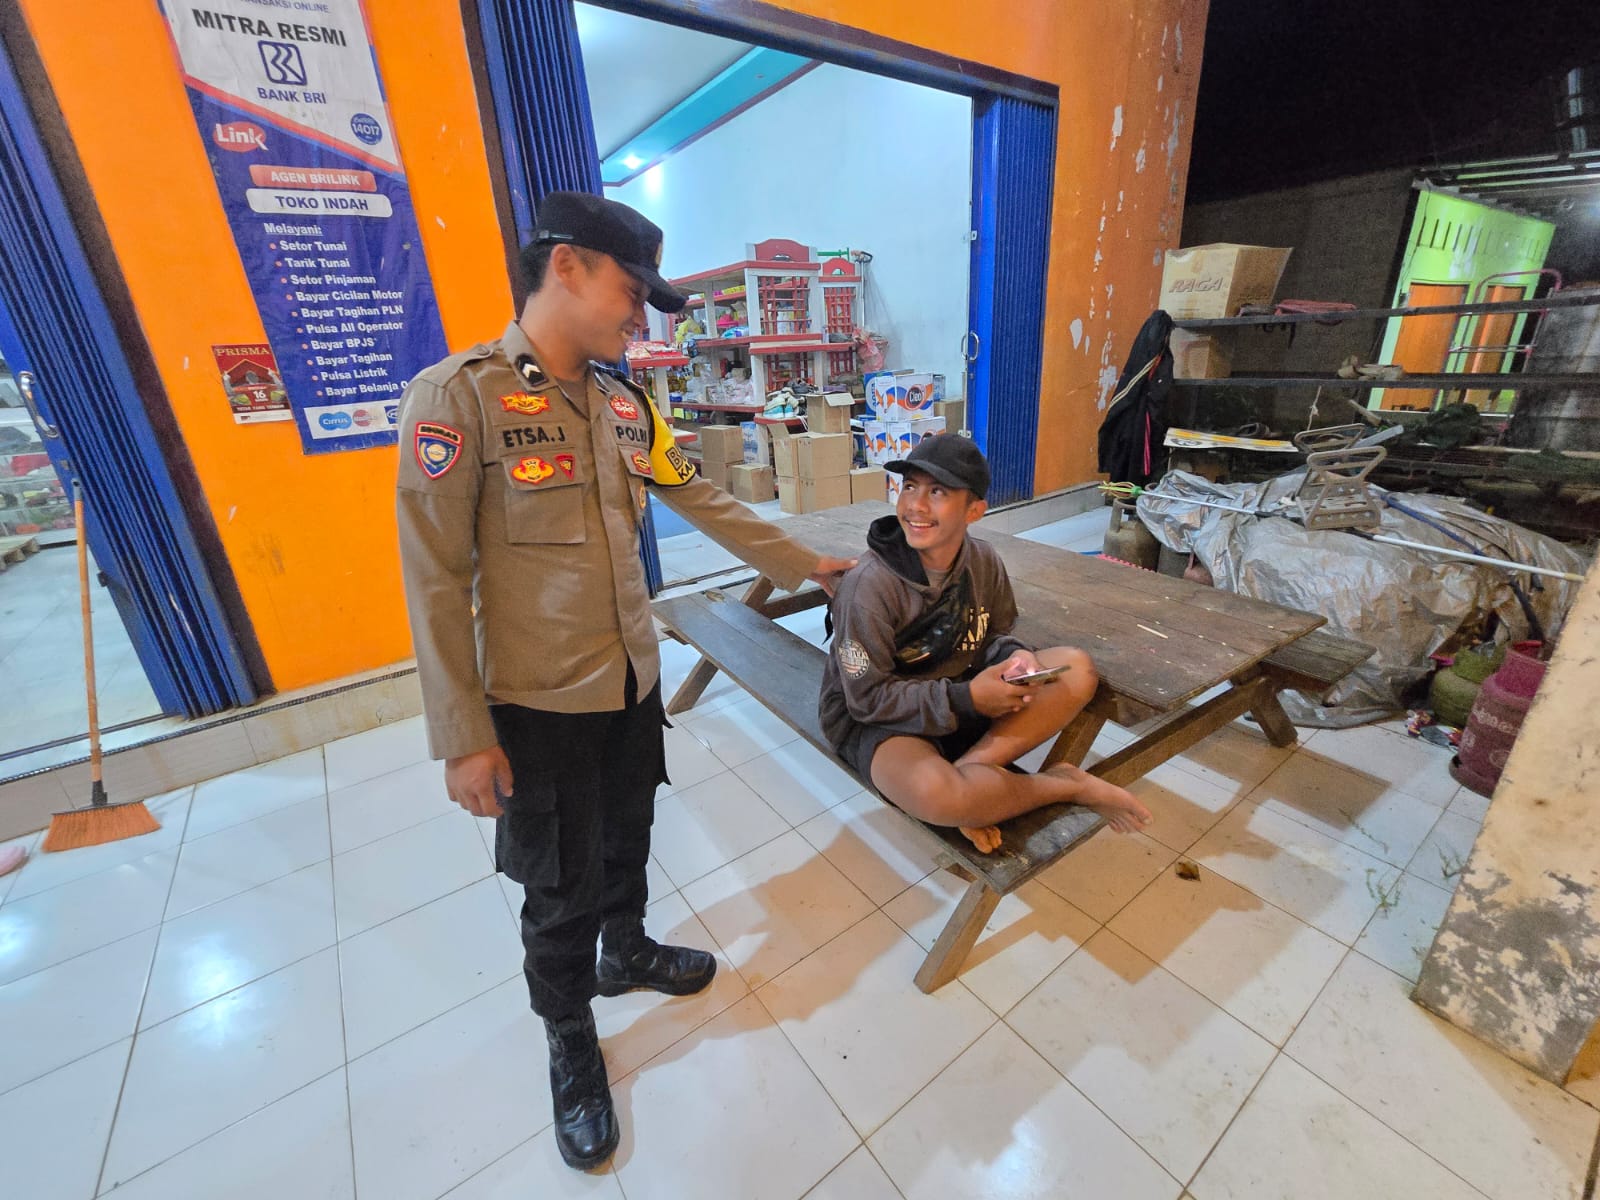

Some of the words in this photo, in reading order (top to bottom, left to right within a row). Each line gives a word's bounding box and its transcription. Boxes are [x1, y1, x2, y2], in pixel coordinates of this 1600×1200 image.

[294, 2, 329, 13] ONLINE
[192, 9, 273, 38] MITRA
[277, 22, 347, 47] RESMI
[257, 87, 299, 103] BANK
[303, 91, 327, 104] BRI
[352, 123, 380, 136] 14017
[215, 124, 269, 150] Link
[271, 171, 306, 184] AGEN
[310, 173, 360, 186] BRILINK
[275, 195, 319, 209] TOKO
[323, 198, 369, 211] INDAH
[264, 222, 322, 236] Melayani:
[280, 241, 313, 251] Setor
[315, 242, 347, 251] Tunai
[285, 258, 316, 268] Tarik
[318, 258, 350, 268] Tunai
[291, 275, 322, 285] Setor
[325, 275, 376, 286] Pinjaman
[296, 292, 330, 303] Bayar
[332, 290, 370, 301] Cicilan
[373, 290, 403, 299] Motor
[301, 308, 335, 319] Bayar
[336, 307, 380, 318] Tagihan
[382, 305, 404, 315] PLN
[306, 324, 338, 334] Pulsa
[340, 323, 355, 332] All
[358, 321, 403, 333] Operator
[216, 347, 270, 357] PRISMA
[311, 341, 344, 352] Bayar
[316, 357, 349, 367] Bayar
[351, 353, 393, 365] Tagihan
[321, 371, 352, 381] Pulsa
[353, 369, 387, 379] Listrik
[253, 390, 267, 399] 16
[326, 387, 358, 398] Bayar
[360, 382, 398, 395] Belanja
[615, 425, 647, 443] POLRI
